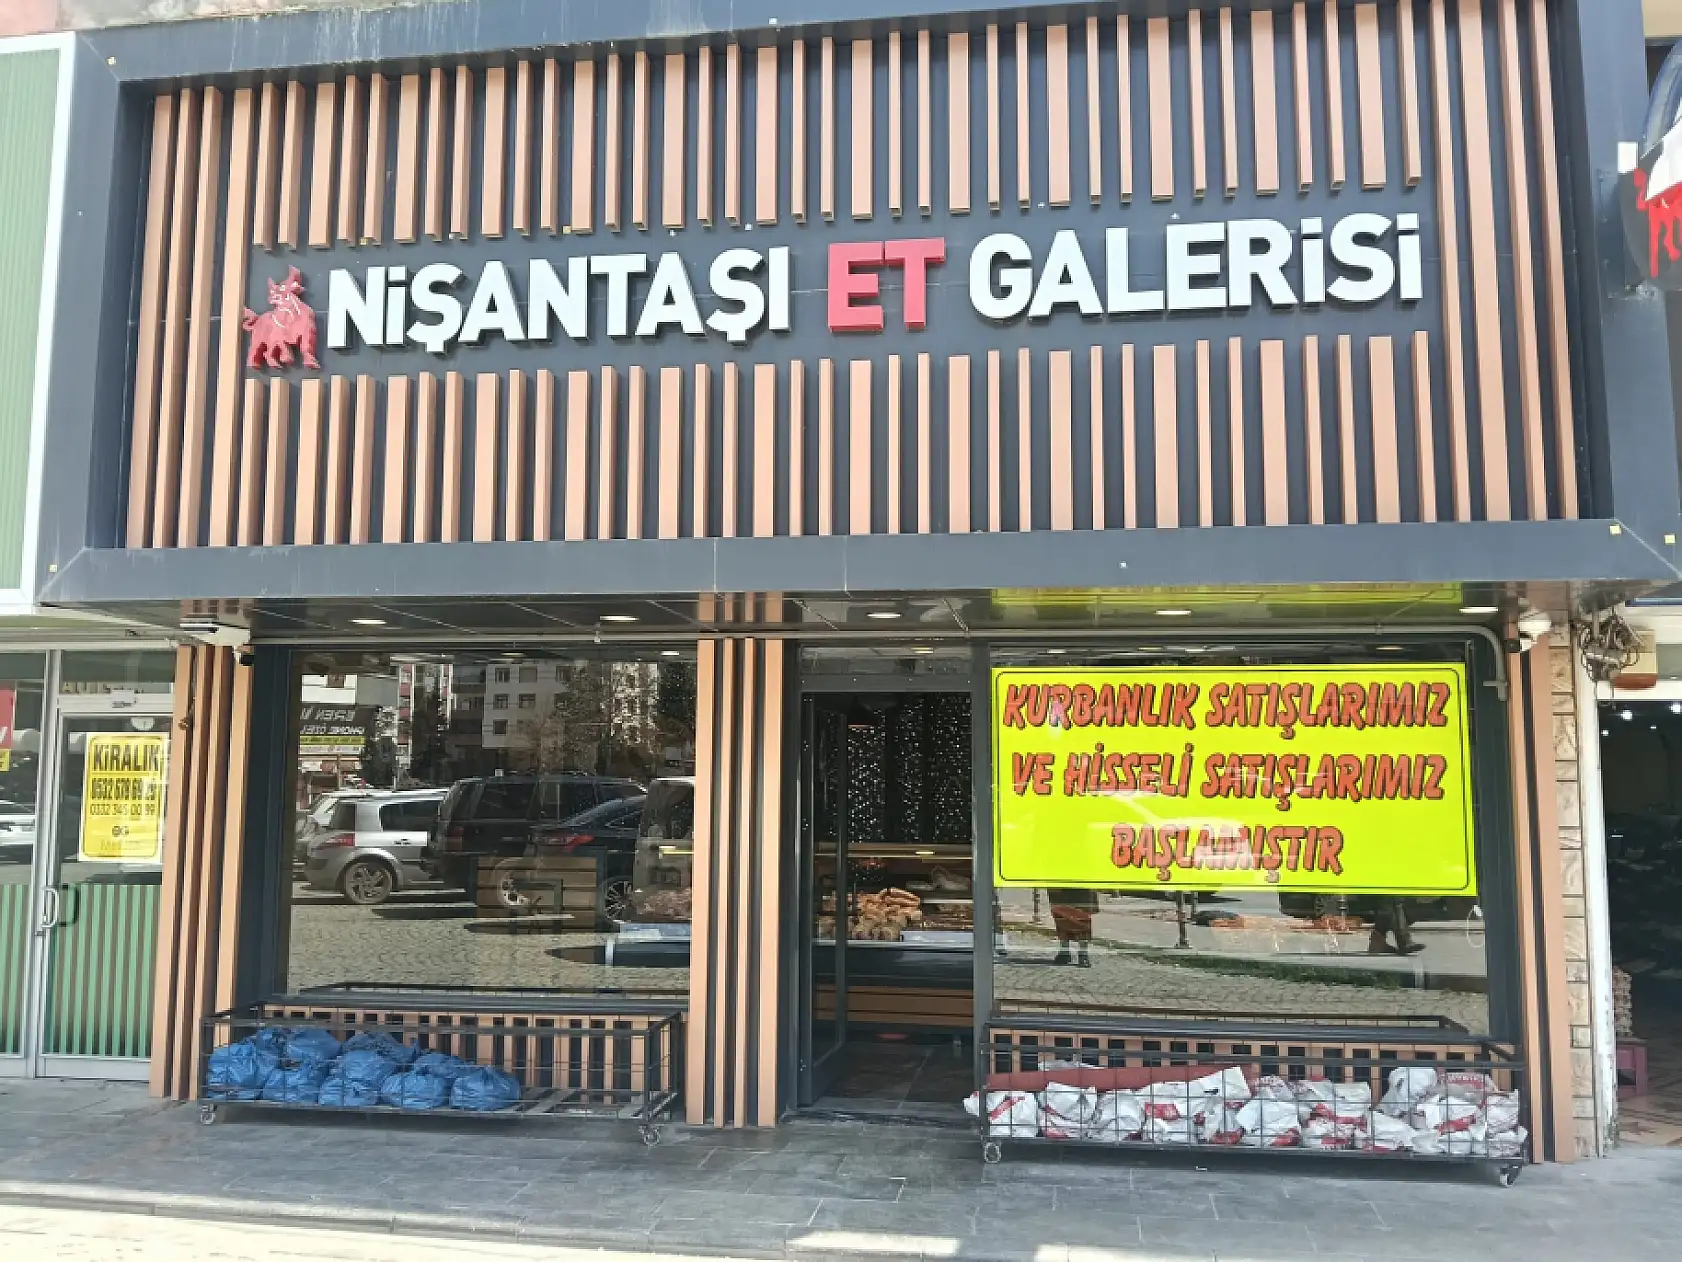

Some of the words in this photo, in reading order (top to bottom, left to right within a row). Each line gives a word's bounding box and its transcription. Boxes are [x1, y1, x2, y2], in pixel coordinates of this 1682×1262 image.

[826, 236, 945, 332] ET
[1003, 682, 1200, 729] KURBANLIK
[1204, 682, 1451, 740] SATIŞLARIMIZ
[1011, 752, 1055, 797] VE
[1200, 753, 1448, 811] SATIŞLARIMIZ
[1110, 824, 1344, 884] BAŞLAMIŞTIR
